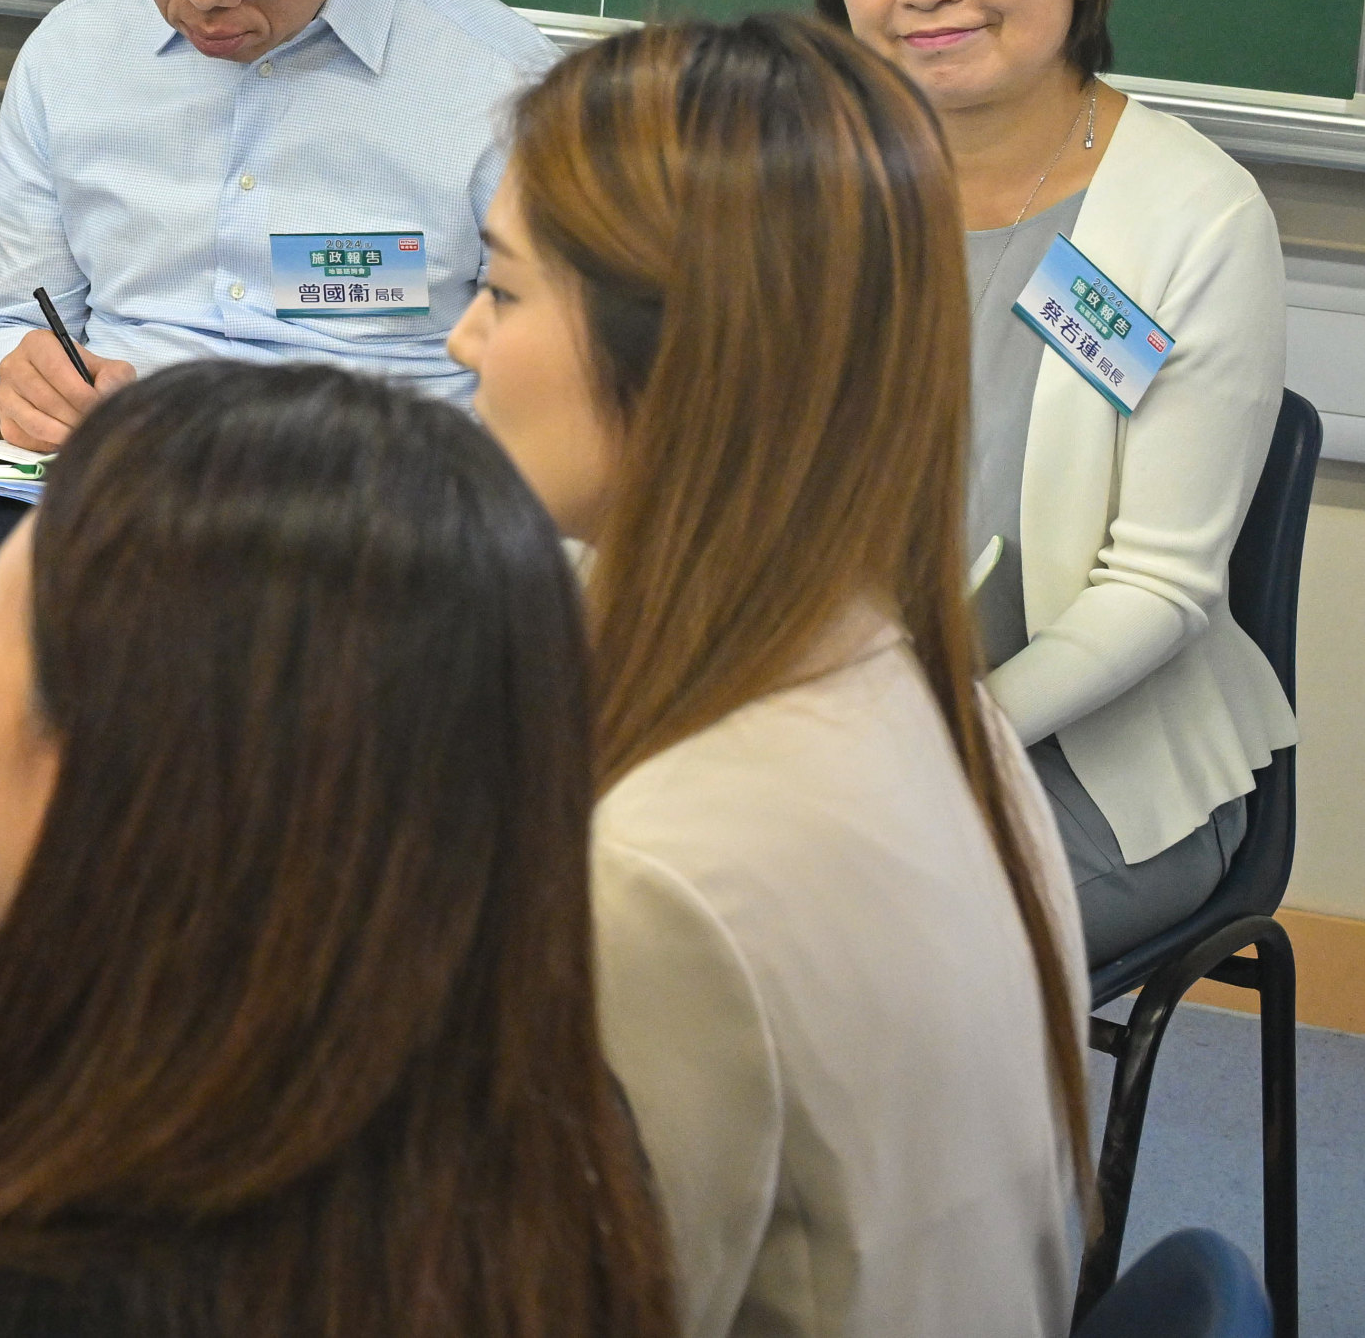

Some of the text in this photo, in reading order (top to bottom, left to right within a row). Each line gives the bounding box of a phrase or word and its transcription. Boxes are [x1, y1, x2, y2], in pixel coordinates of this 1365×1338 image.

[311, 250, 381, 266] 施政報告
[375, 287, 406, 302] 局長
[1072, 278, 1130, 336] 施政報告
[1039, 296, 1125, 387] 蔡若蓮 局長
